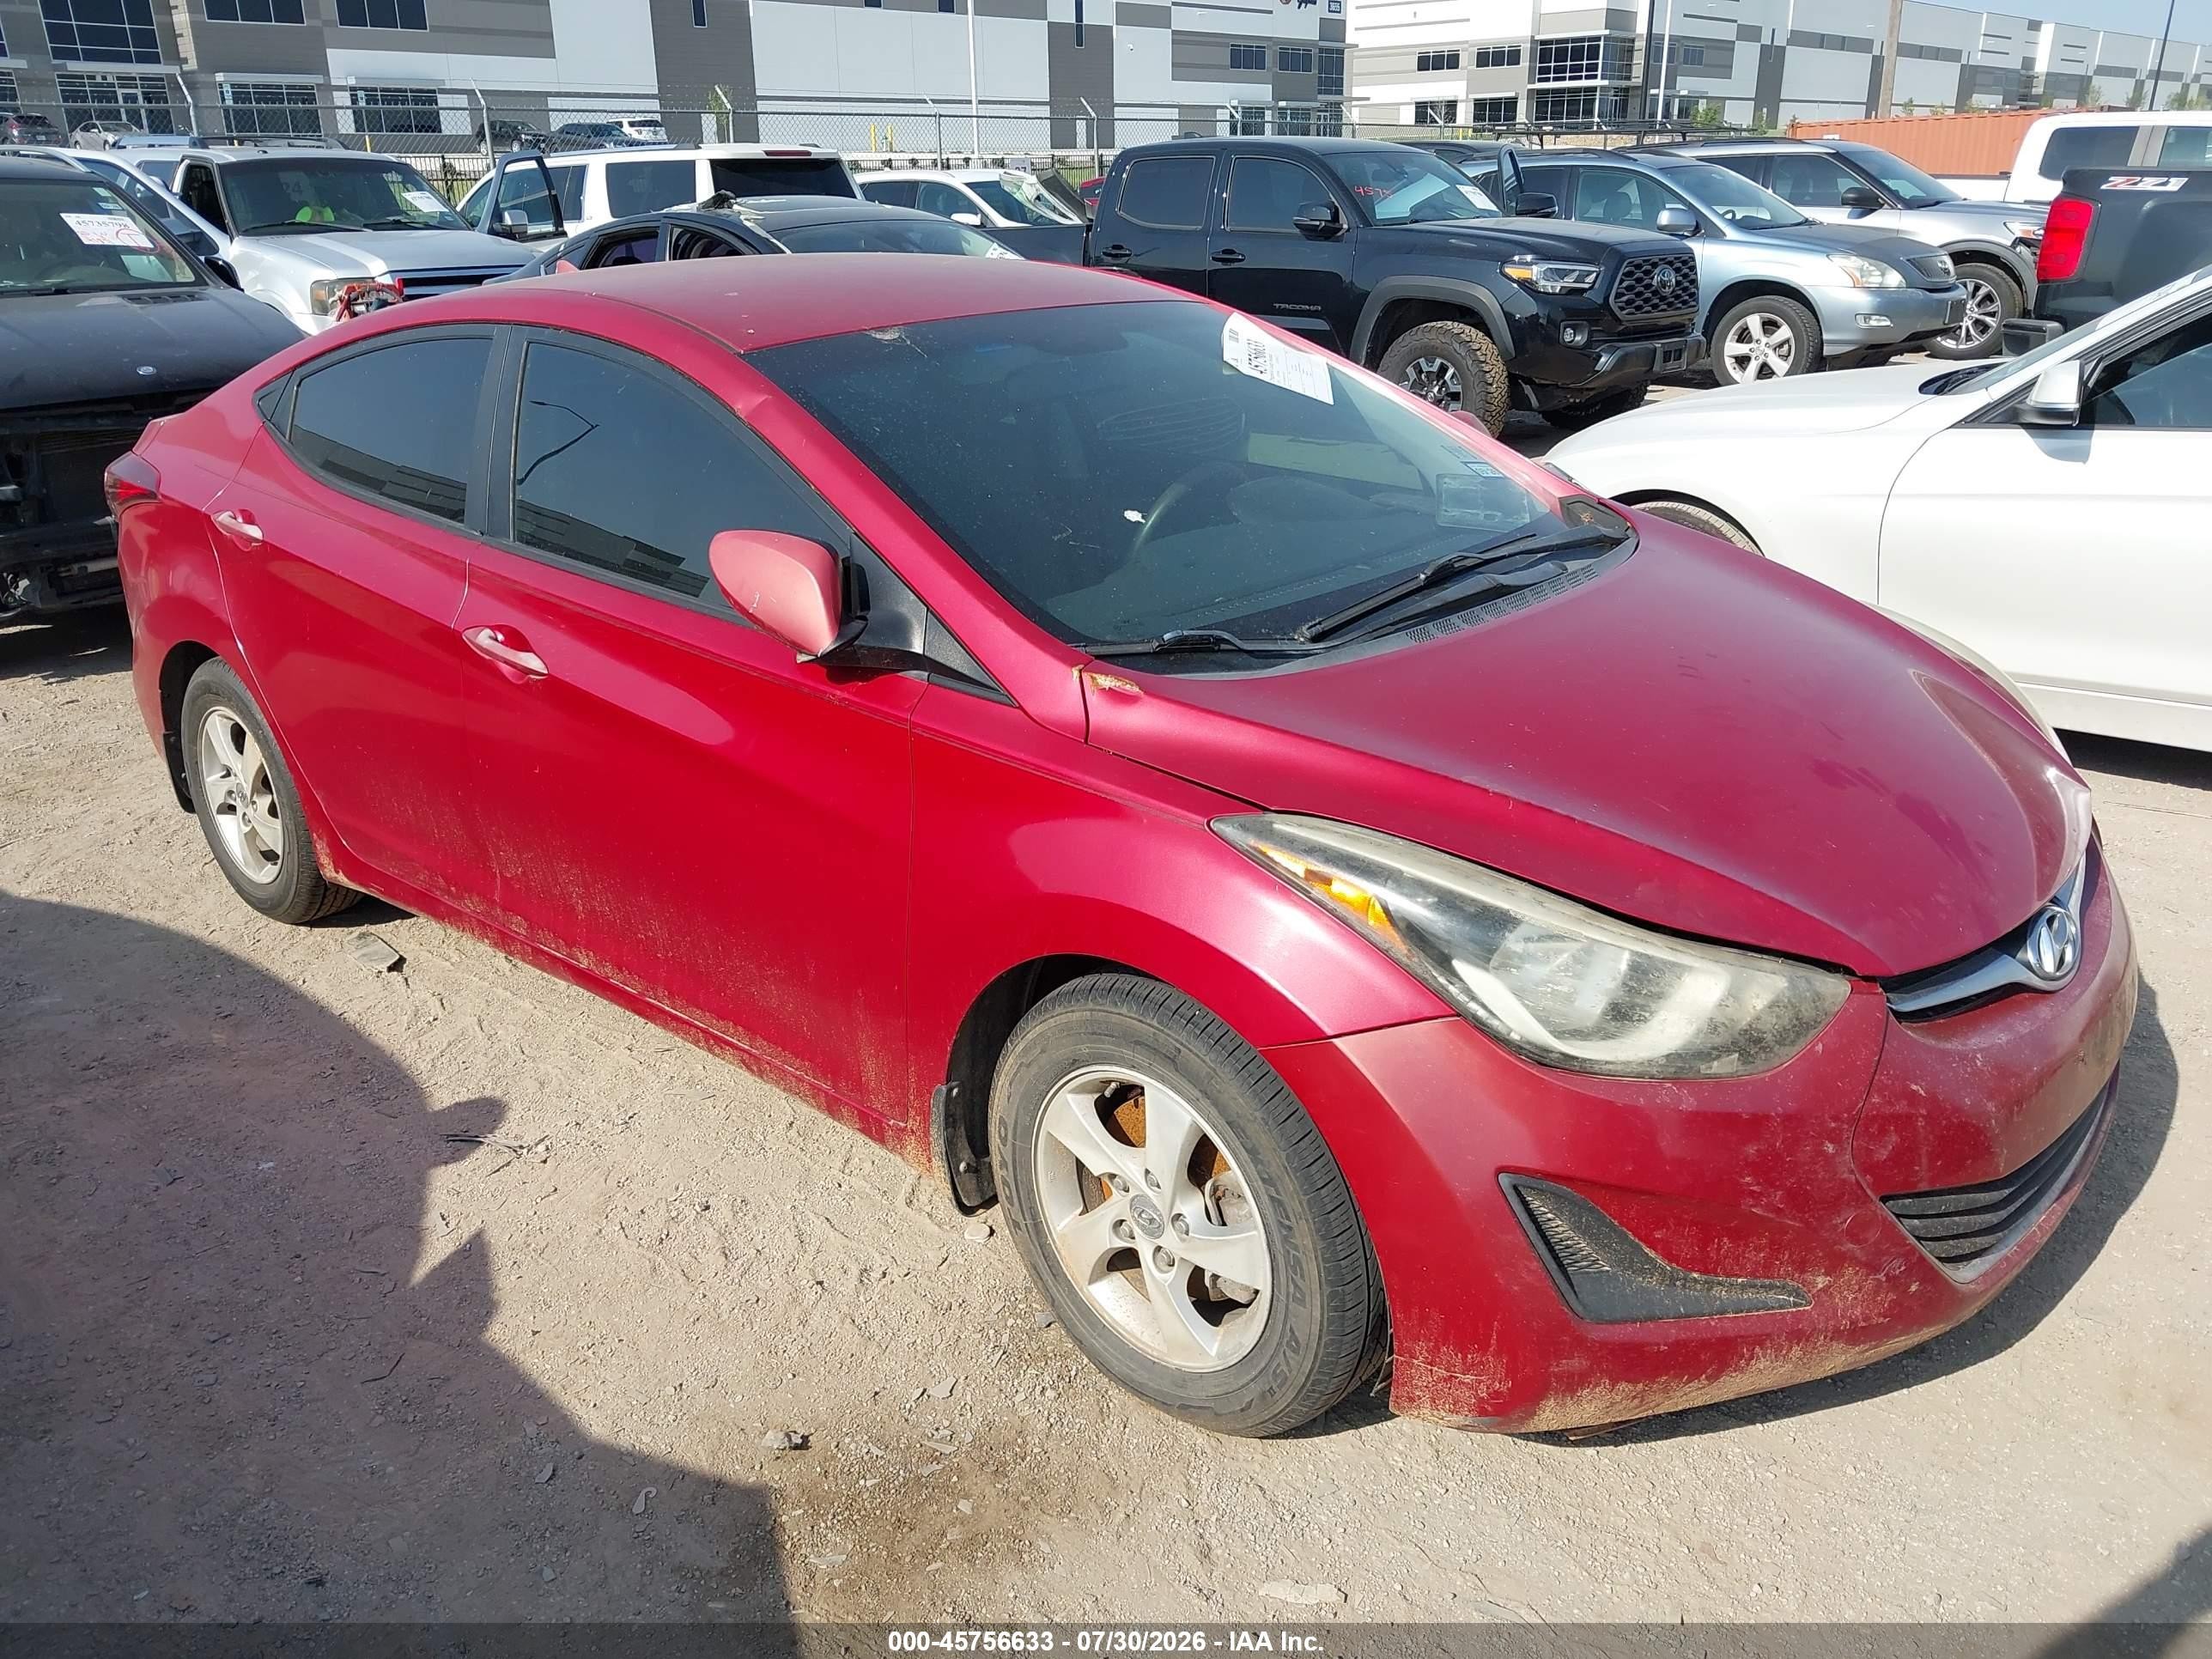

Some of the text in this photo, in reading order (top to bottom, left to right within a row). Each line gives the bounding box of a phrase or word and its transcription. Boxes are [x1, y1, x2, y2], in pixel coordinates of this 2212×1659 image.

[2100, 176, 2189, 191] Z71
[1273, 303, 1322, 312] TACOMA
[998, 1115, 1022, 1237] TOYO
